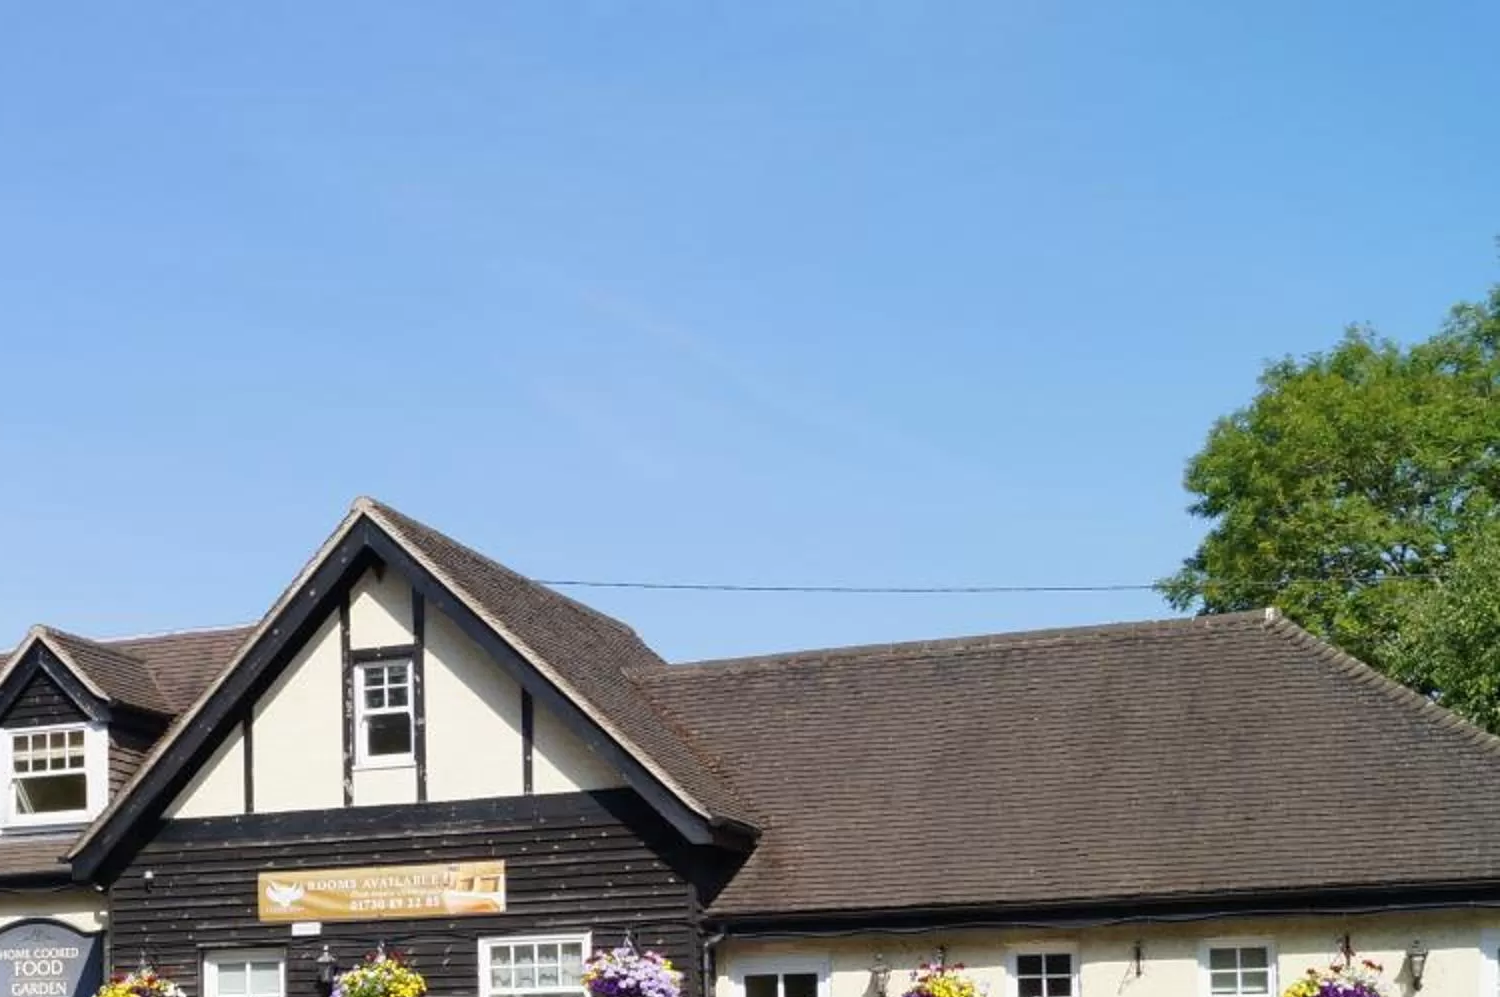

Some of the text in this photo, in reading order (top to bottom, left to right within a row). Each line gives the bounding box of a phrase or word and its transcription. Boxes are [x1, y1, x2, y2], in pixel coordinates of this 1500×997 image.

[307, 878, 357, 891] ROOMS
[0, 946, 79, 960] HOME COOKED
[14, 959, 63, 977] FOOD
[11, 981, 68, 997] GARDEN
